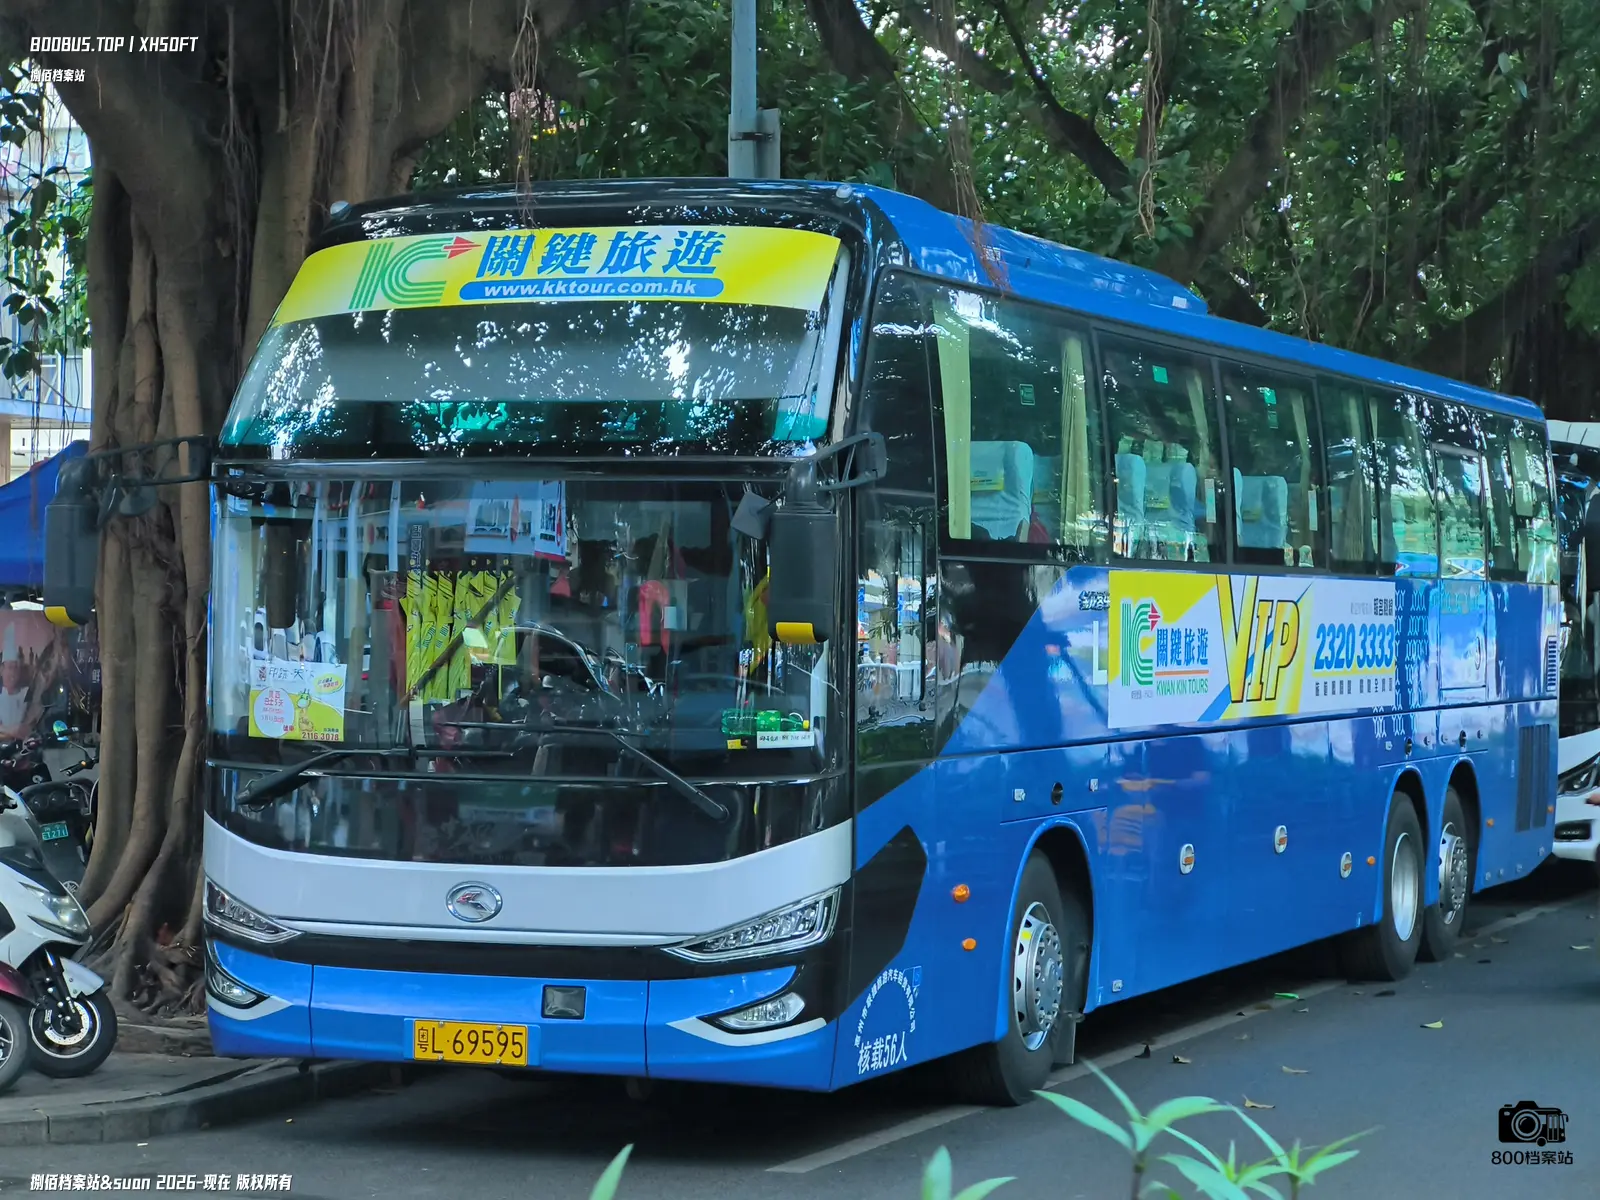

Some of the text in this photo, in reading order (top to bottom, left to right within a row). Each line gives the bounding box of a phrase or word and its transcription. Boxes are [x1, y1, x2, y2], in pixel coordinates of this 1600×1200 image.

[475, 231, 726, 278] 關鍵旅遊
[484, 282, 697, 297] www.kktour.com.hk
[1156, 628, 1208, 667] 關鍵旅遊
[1216, 574, 1300, 703] VIP
[1314, 623, 1394, 670] 2320 3333
[1156, 680, 1175, 696] KWAN
[1177, 680, 1187, 694] KIN
[1188, 678, 1208, 694] TOURS
[302, 732, 339, 740] 2116 3078
[858, 1031, 907, 1074] 核载56人
